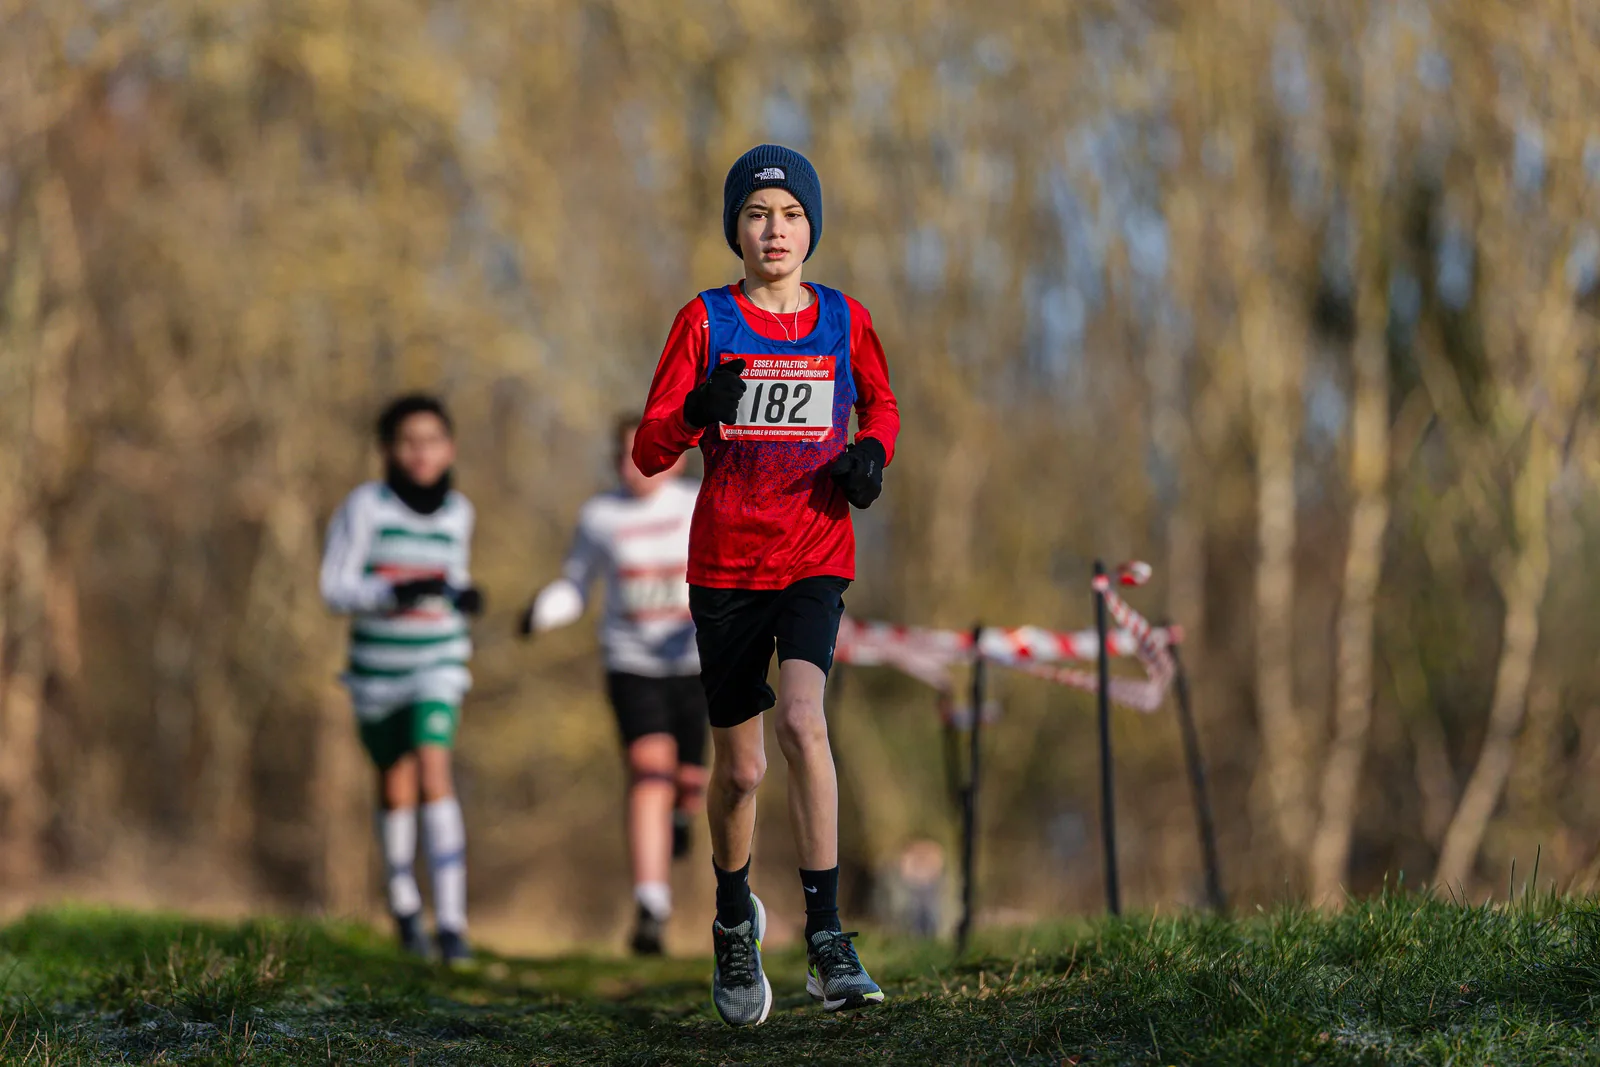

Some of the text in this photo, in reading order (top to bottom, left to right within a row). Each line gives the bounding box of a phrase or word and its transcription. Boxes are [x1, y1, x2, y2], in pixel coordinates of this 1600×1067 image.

[753, 360, 808, 369] ESSEX ATHLETICS
[750, 369, 780, 377] COUNTRY
[781, 370, 829, 378] CHAMPIONSHIPS
[750, 382, 812, 424] 182
